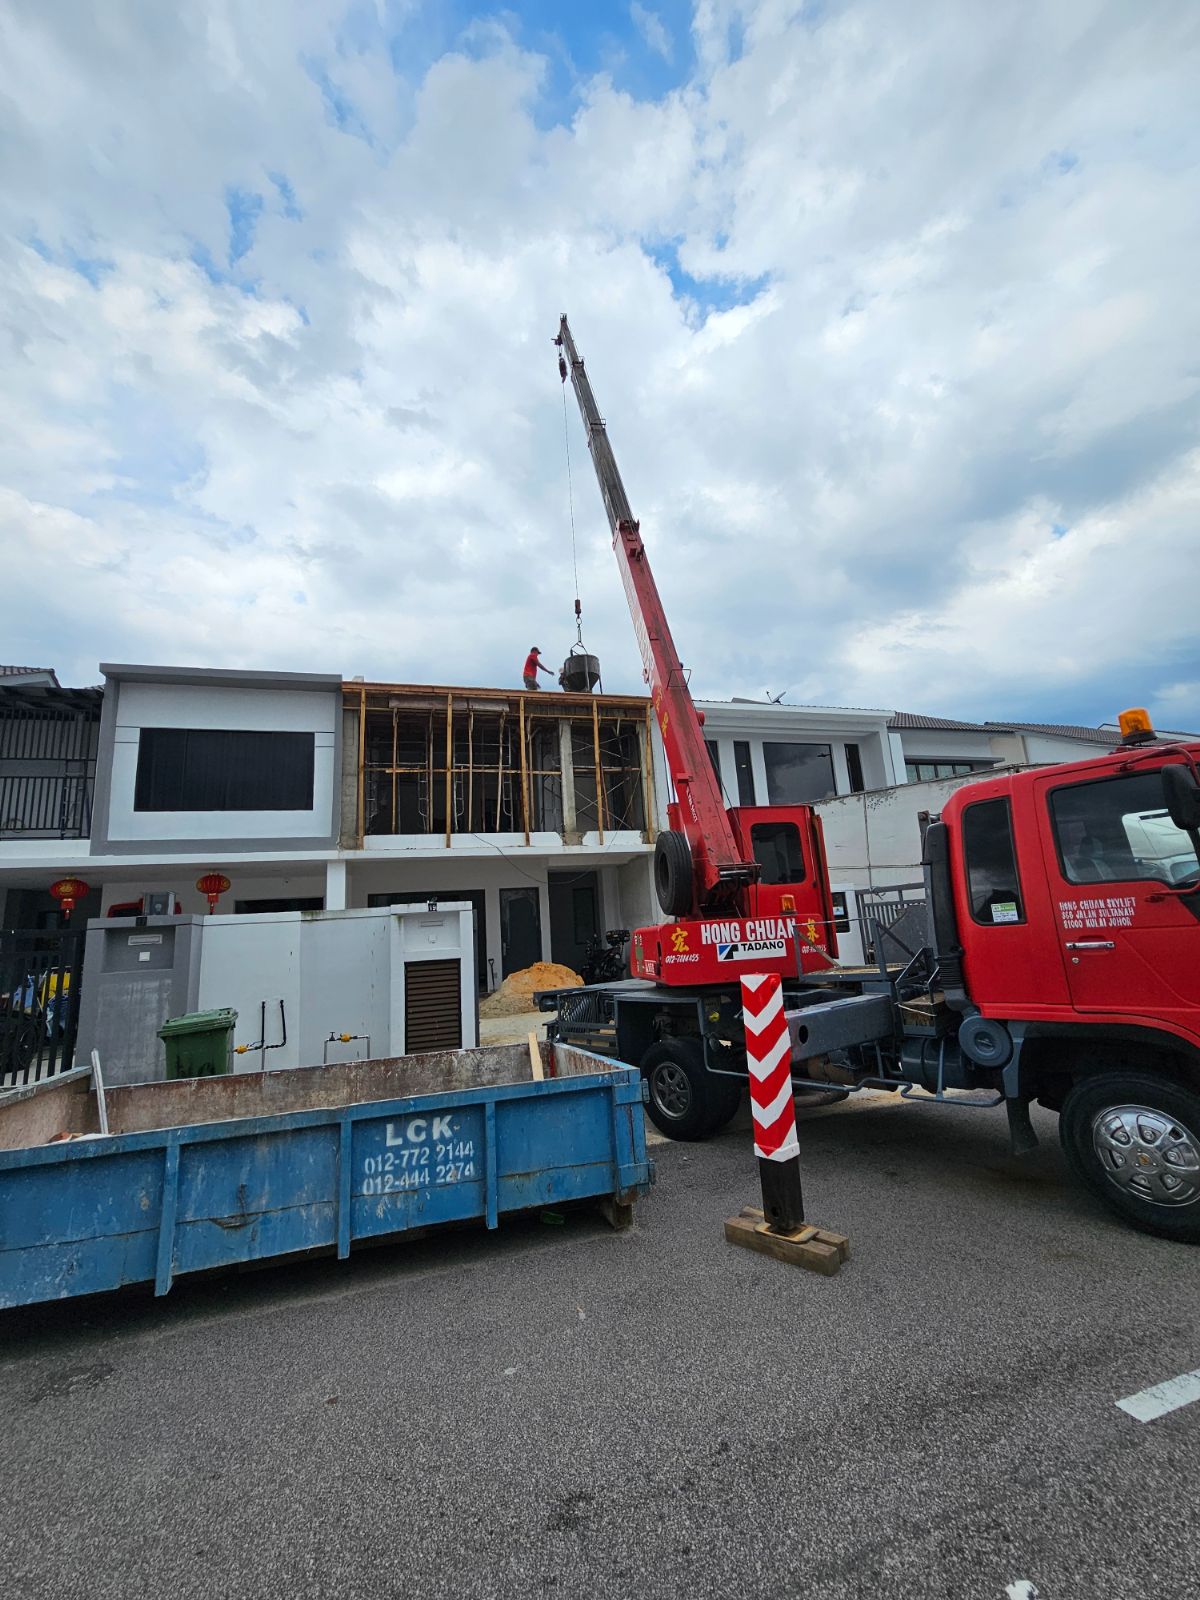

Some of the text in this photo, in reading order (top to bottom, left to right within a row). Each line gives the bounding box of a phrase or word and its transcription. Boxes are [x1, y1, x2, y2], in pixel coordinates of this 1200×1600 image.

[1059, 897, 1136, 911] HONG CHUAN SKYLIFT
[1076, 909, 1097, 919] JALAN
[1099, 907, 1134, 917] SULTANAH
[701, 918, 795, 945] HONG CHUAN
[1063, 917, 1132, 929] 81000 KULAI JOHOR
[741, 941, 784, 952] TADANO
[385, 1115, 453, 1147] LCK
[364, 1141, 475, 1175] 012-772 2144
[362, 1161, 475, 1195] 012-444 2274
